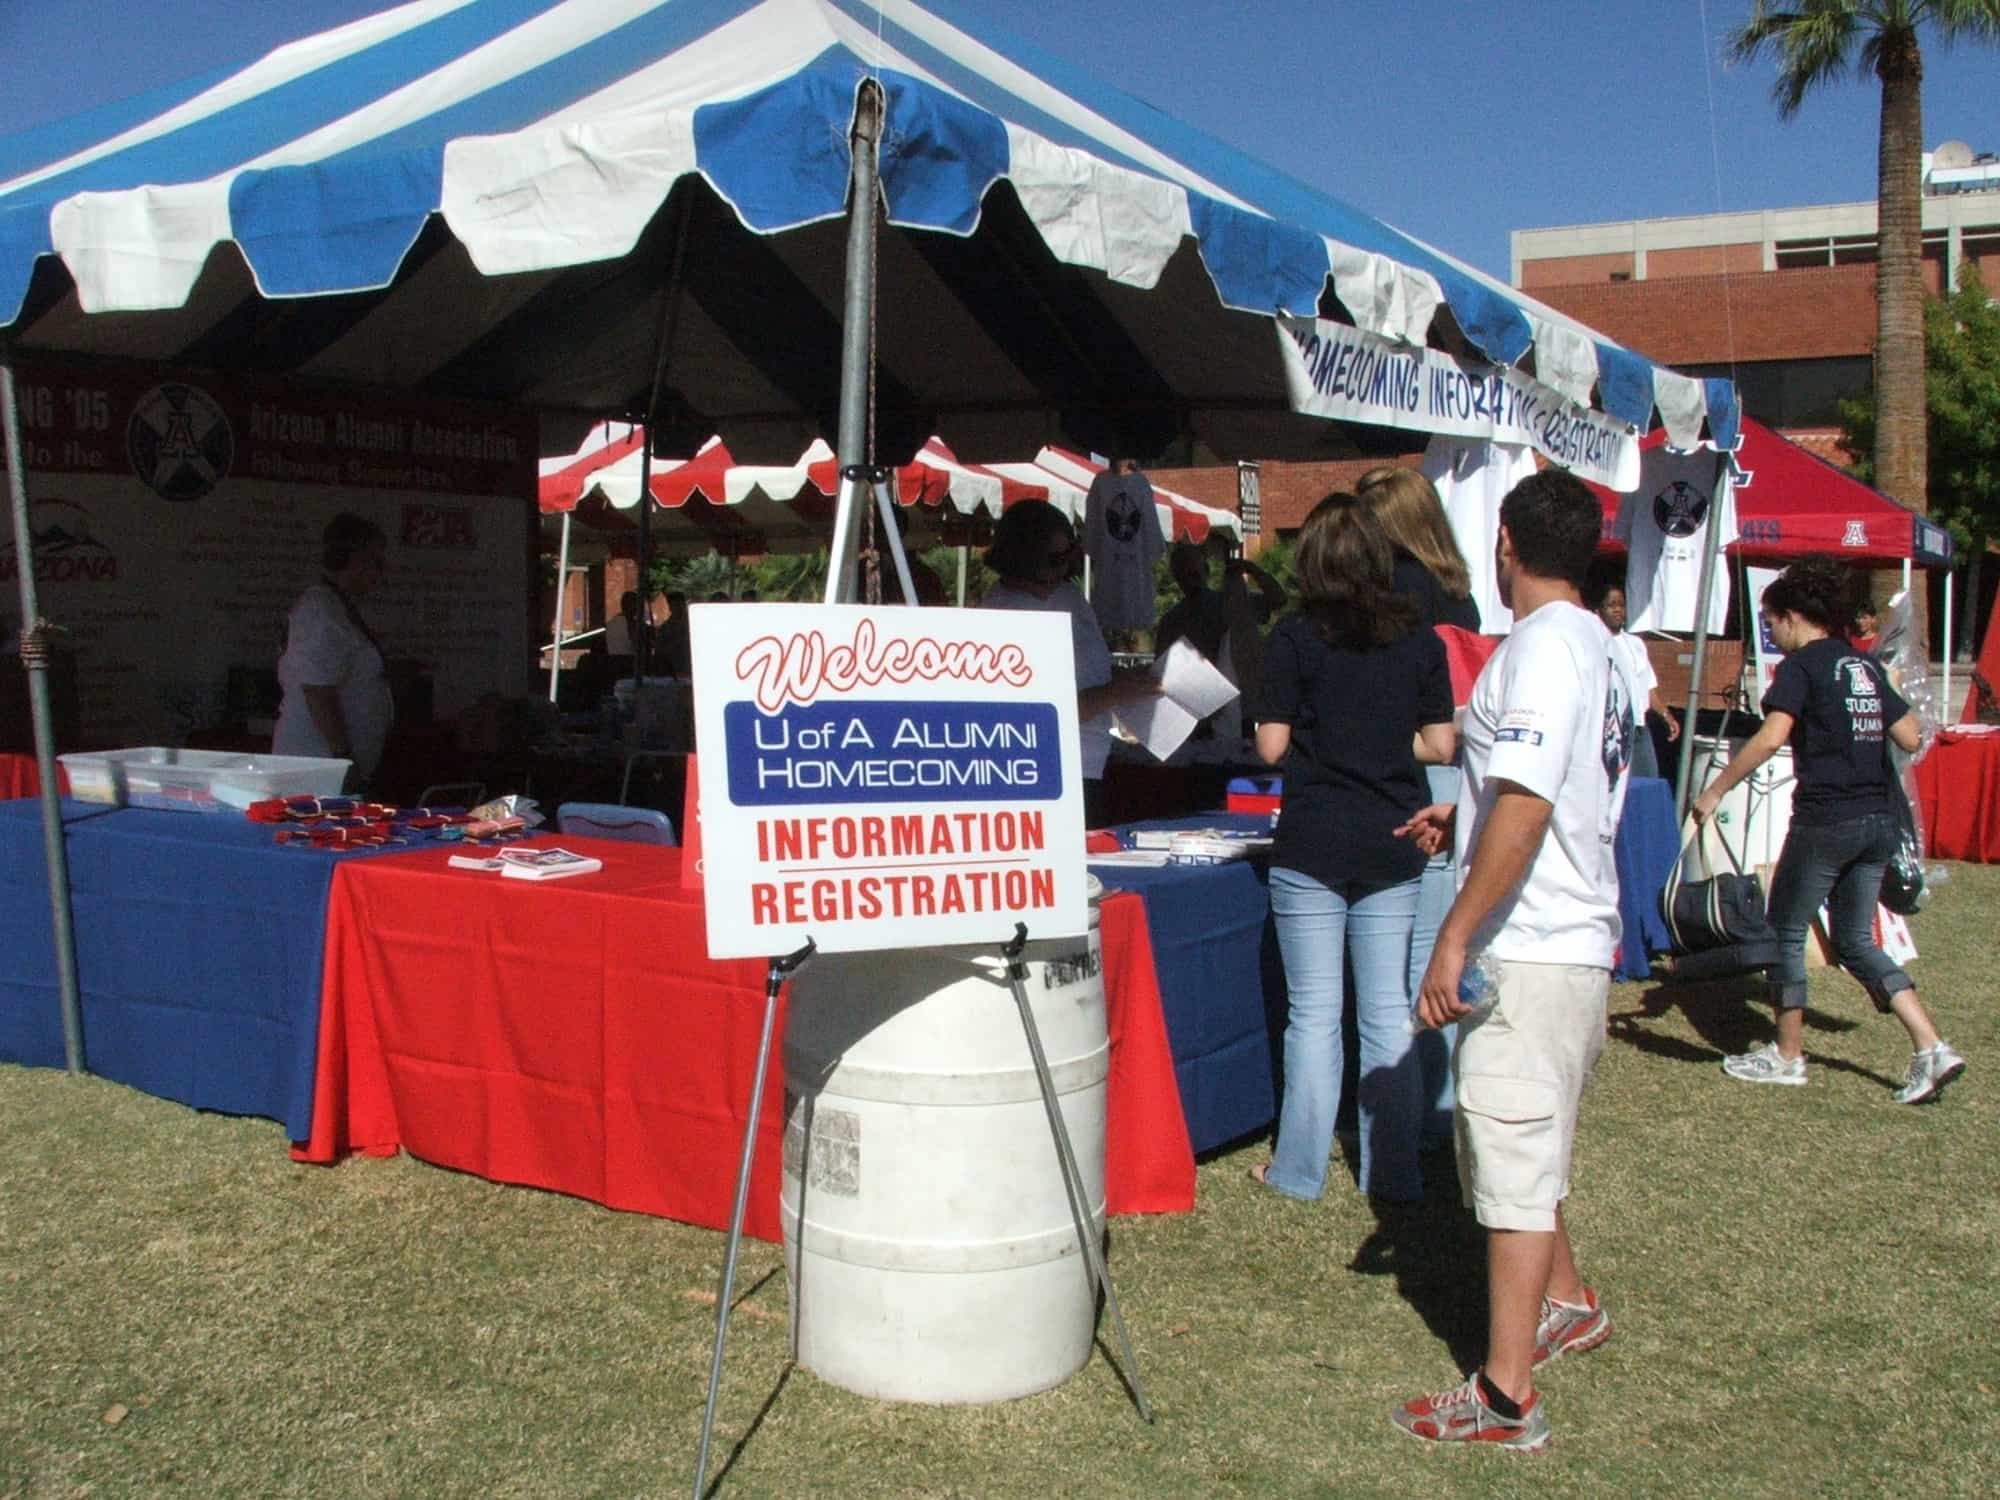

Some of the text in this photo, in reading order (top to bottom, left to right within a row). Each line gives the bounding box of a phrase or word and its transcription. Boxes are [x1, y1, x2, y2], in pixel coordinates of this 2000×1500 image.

[1841, 521, 1869, 547] A
[736, 618, 1032, 712] Welcome
[1845, 697, 1882, 713] STUDEN
[755, 718, 1037, 750] U of A ALUMNI
[758, 757, 1038, 789] HOMECOMING
[756, 811, 1045, 862] INFORMATION
[751, 869, 1055, 925] REGISTRATION
